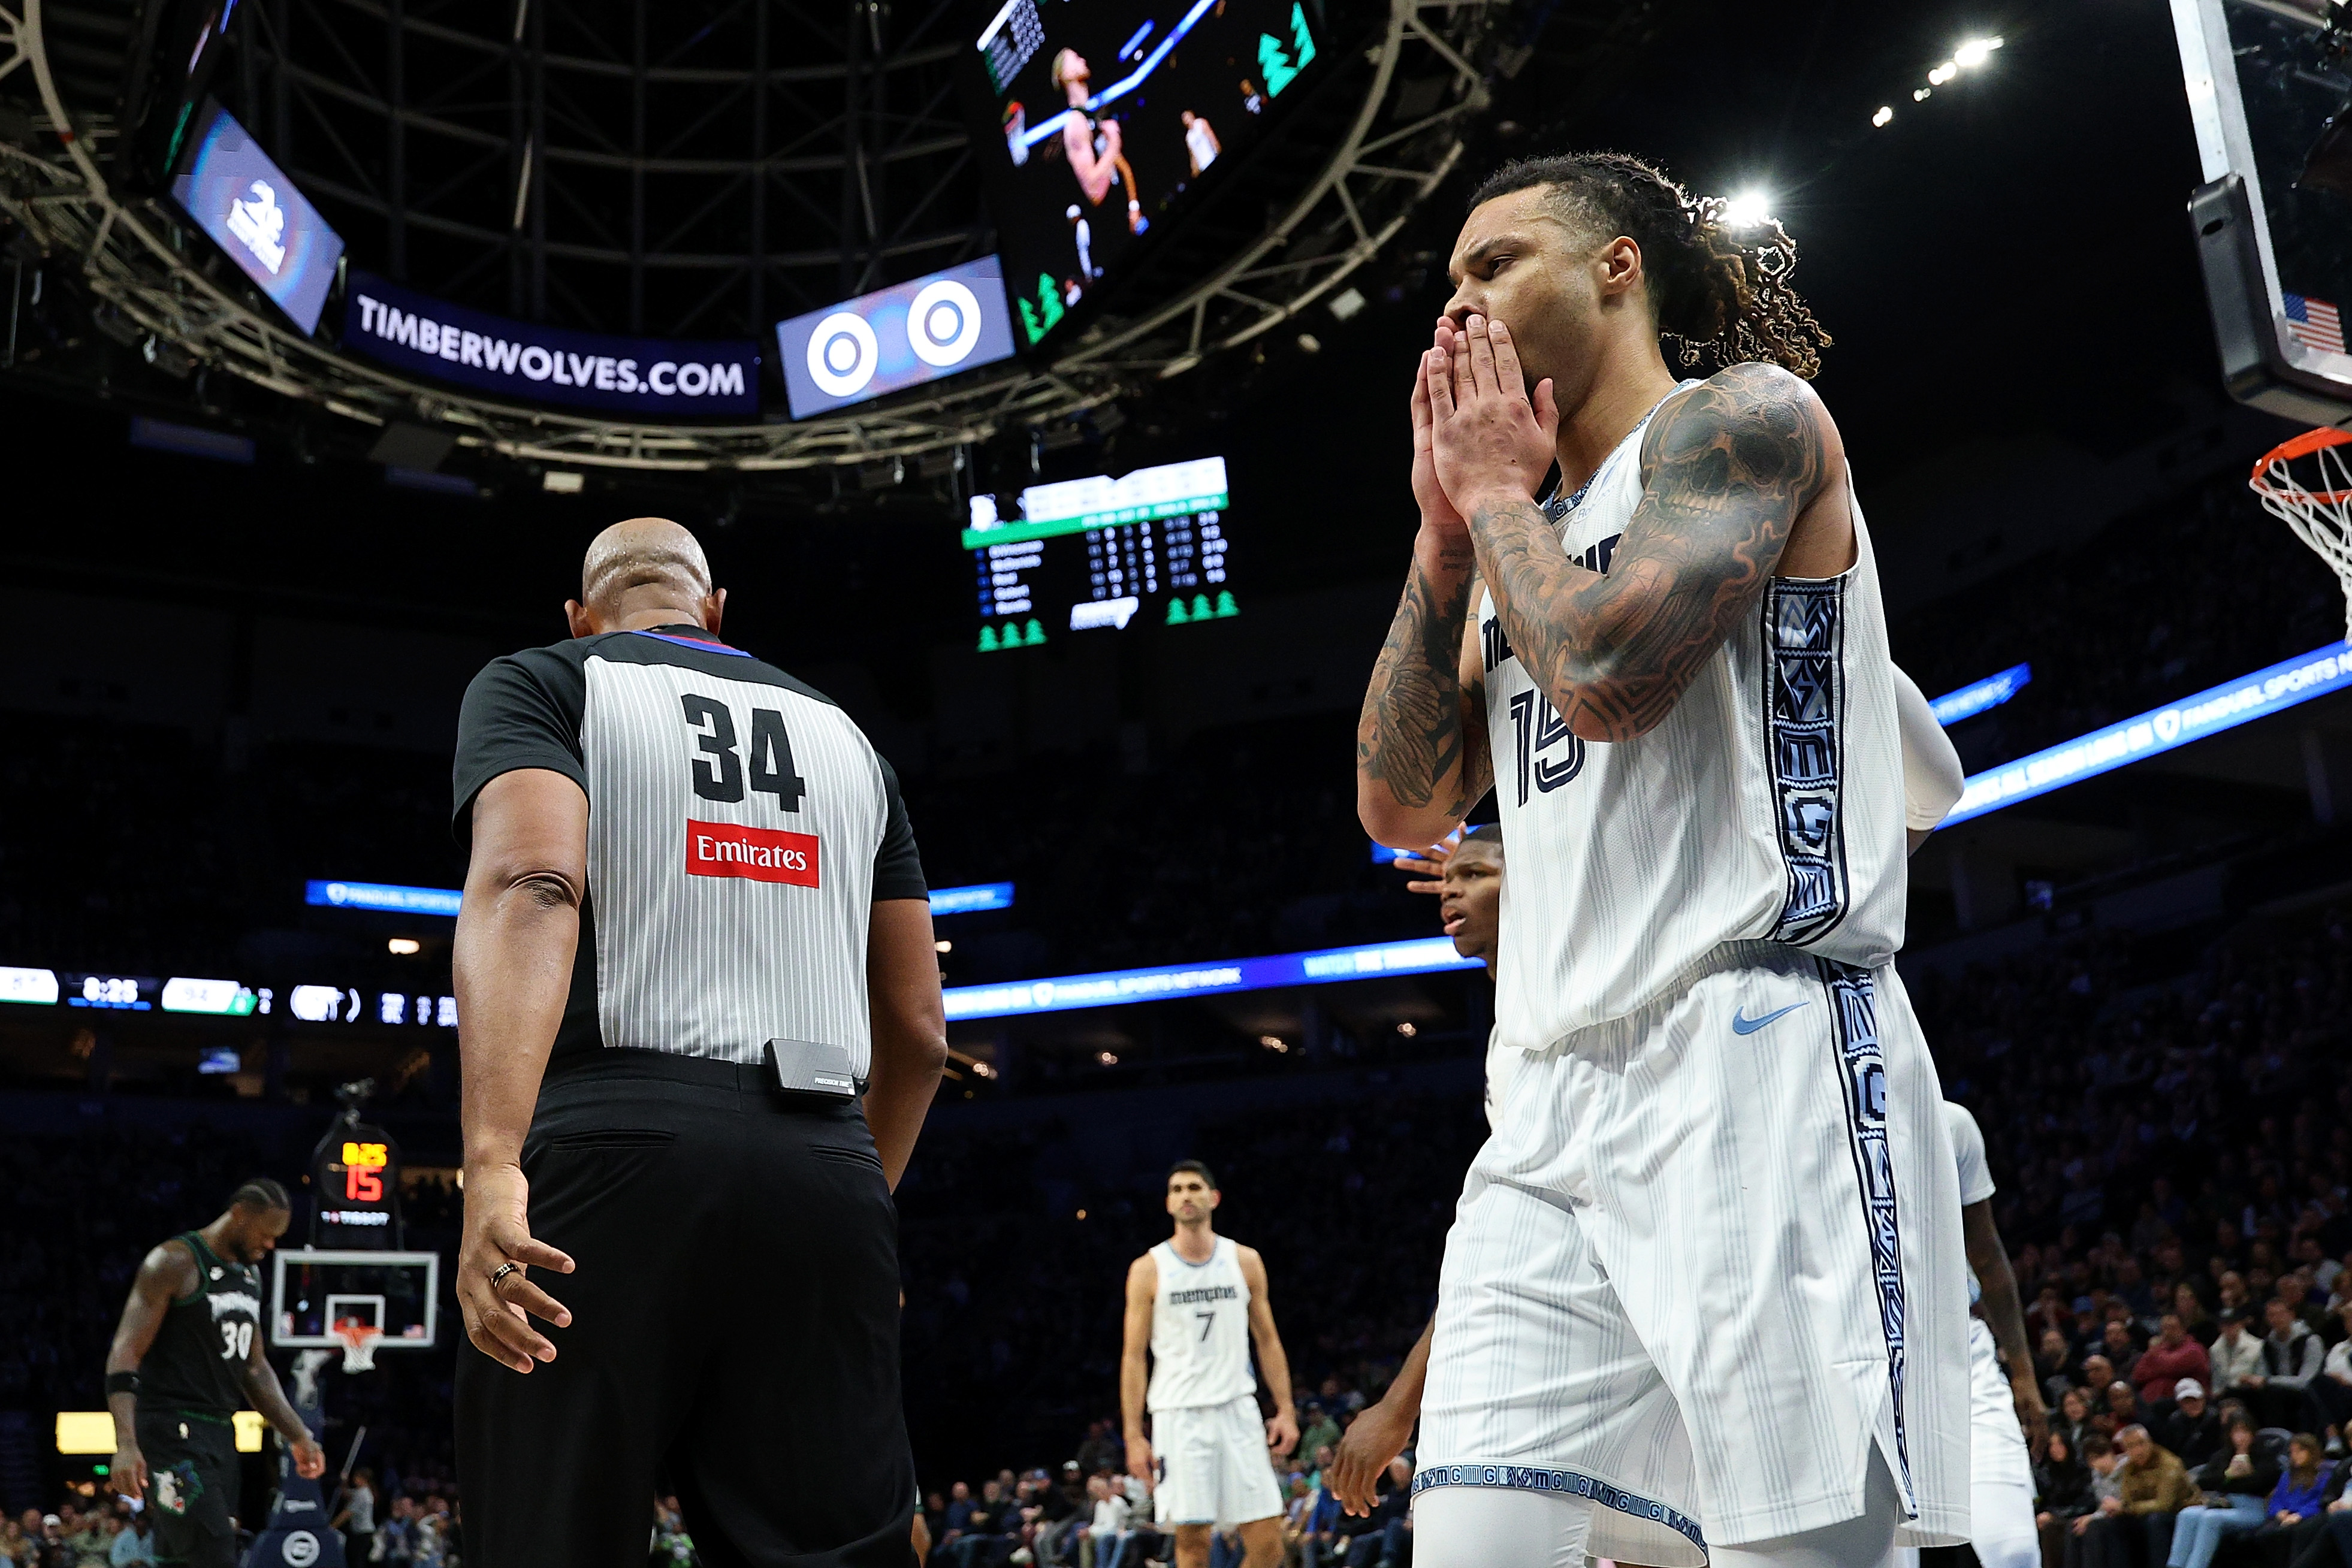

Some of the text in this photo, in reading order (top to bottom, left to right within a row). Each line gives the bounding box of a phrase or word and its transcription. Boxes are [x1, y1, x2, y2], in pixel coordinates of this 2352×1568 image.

[358, 294, 745, 395] TIMBERWOLVES.COM
[2264, 657, 2338, 700] SPORTS
[681, 693, 806, 812] 34
[1511, 689, 1585, 808] 15
[696, 835, 807, 871] Emirates
[346, 1164, 383, 1201] 15
[221, 1320, 253, 1361] 30
[1195, 1312, 1216, 1342] 7
